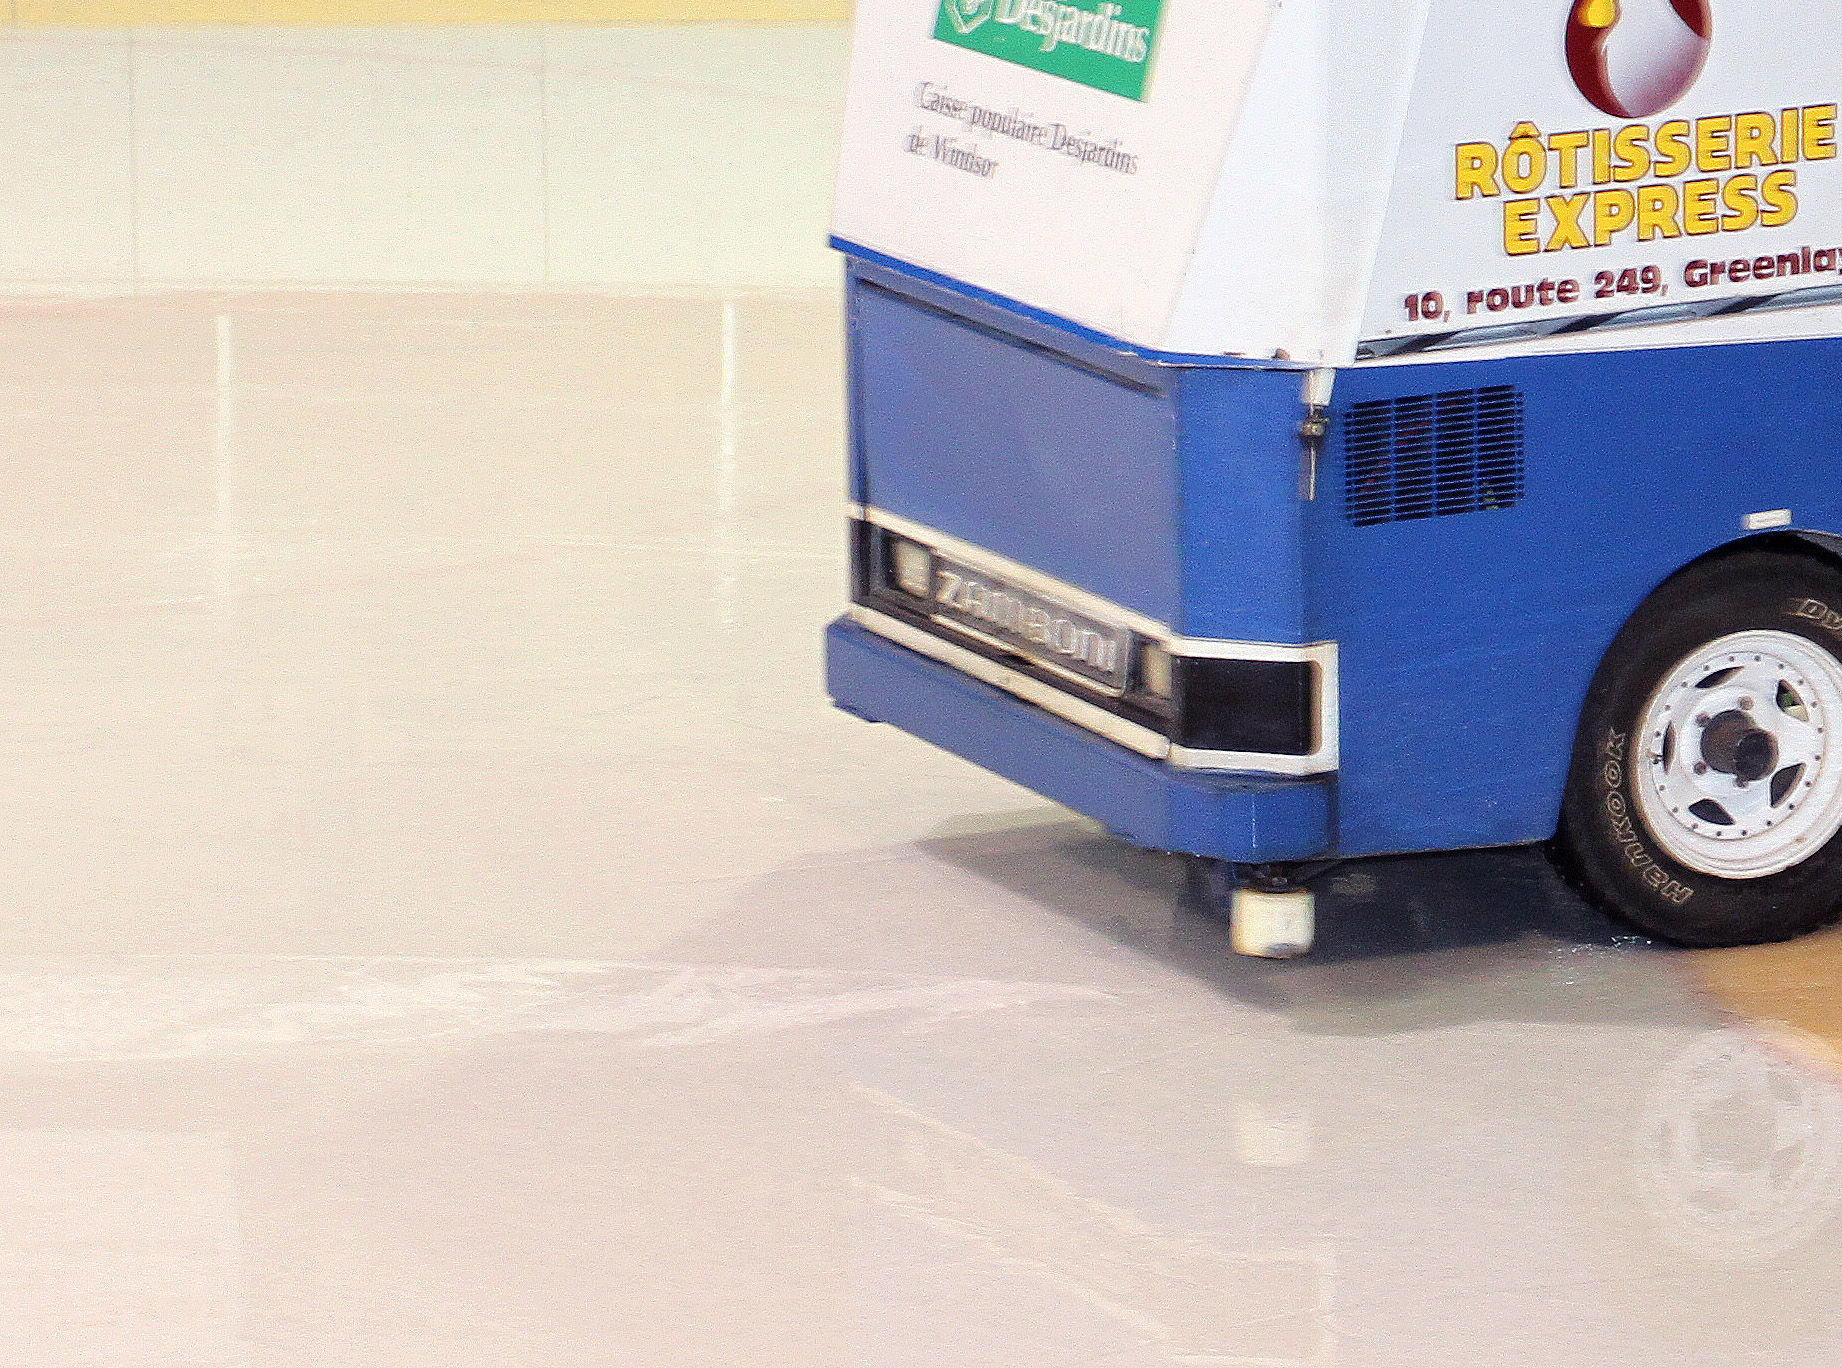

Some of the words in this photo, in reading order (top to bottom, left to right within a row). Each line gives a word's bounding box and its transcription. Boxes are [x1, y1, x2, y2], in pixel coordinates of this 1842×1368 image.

[904, 125, 928, 155] de
[931, 133, 999, 180] Windsor
[914, 82, 968, 119] Caisse
[967, 107, 1048, 146] populaire
[1047, 122, 1140, 175] Desjardins
[1454, 102, 1838, 201] RÔTISSERIE
[1502, 170, 1799, 257] EXPRESS
[1403, 292, 1450, 324] 10,
[1467, 277, 1580, 315] route
[1593, 266, 1669, 299] 249,
